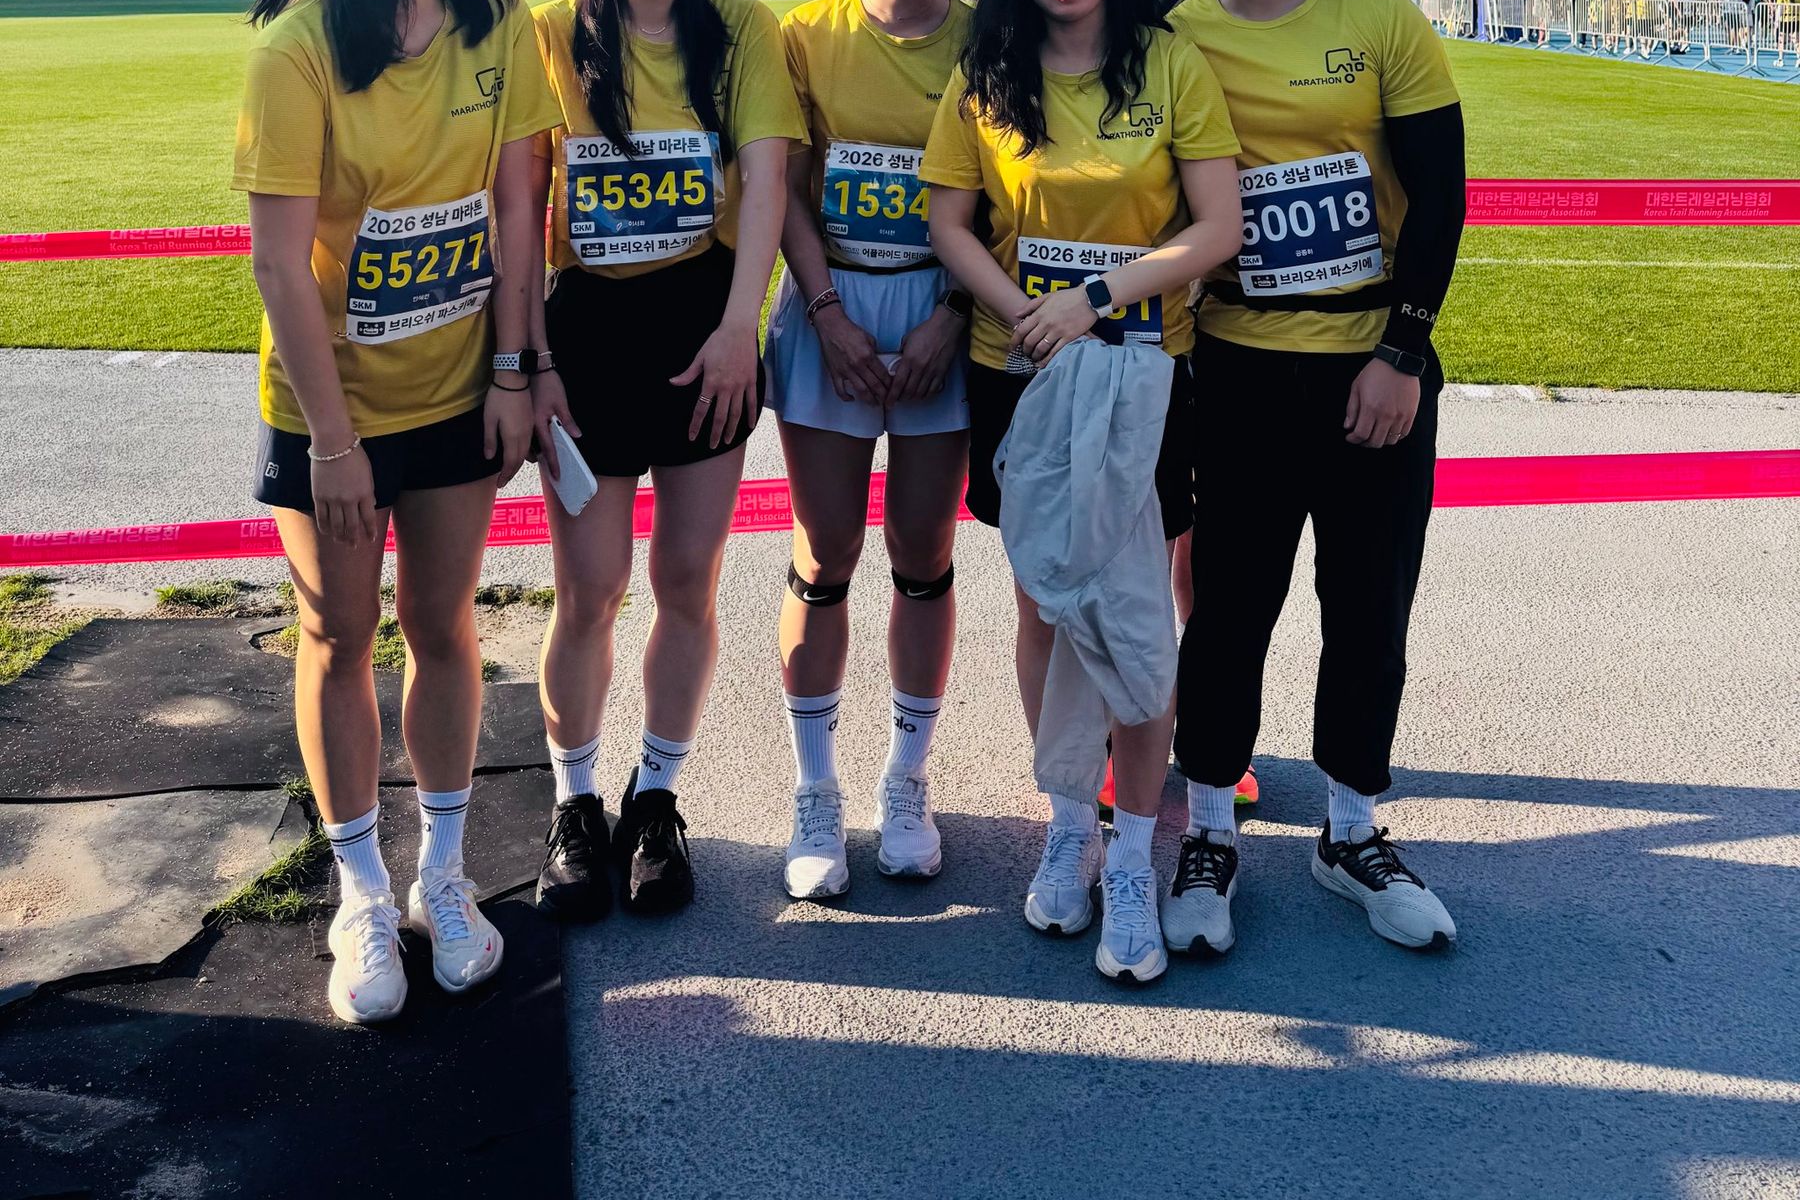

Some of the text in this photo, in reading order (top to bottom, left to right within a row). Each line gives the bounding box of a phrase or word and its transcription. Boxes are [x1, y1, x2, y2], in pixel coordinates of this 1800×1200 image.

[1289, 75, 1342, 87] MARATHON
[577, 142, 623, 159] 2026
[659, 137, 702, 154] 마라톤
[838, 149, 885, 167] 2026
[888, 154, 915, 171] 성남
[1281, 165, 1311, 185] 성남
[1314, 157, 1359, 179] 마라톤
[575, 168, 707, 213] 55345
[1469, 191, 1599, 207] 대한트레일러닝협회
[1646, 191, 1772, 207] 대한트레일러닝협회
[366, 198, 484, 236] 2026 성남 마라톤
[1242, 190, 1371, 246] 50018
[1467, 208, 1597, 219] Korea Trail Running Association
[1643, 208, 1770, 220] Korea Trail Running Association
[573, 224, 592, 232] 5KM
[828, 224, 847, 233] 10KM
[110, 242, 141, 252] Korea
[142, 241, 166, 251] Trail
[168, 240, 213, 251] Running
[608, 239, 655, 255] 브리오쉬
[862, 247, 902, 260] 어플라이드
[355, 230, 486, 291] 55277
[1027, 243, 1150, 267] 2026 성남 마라
[1241, 256, 1261, 265] 5KM
[1279, 256, 1374, 286] 브리오쉬 파스키에
[351, 300, 373, 311] 5KM
[388, 310, 436, 332] 브리오쉬
[437, 295, 478, 319] 파스키에
[510, 526, 550, 537] Running
